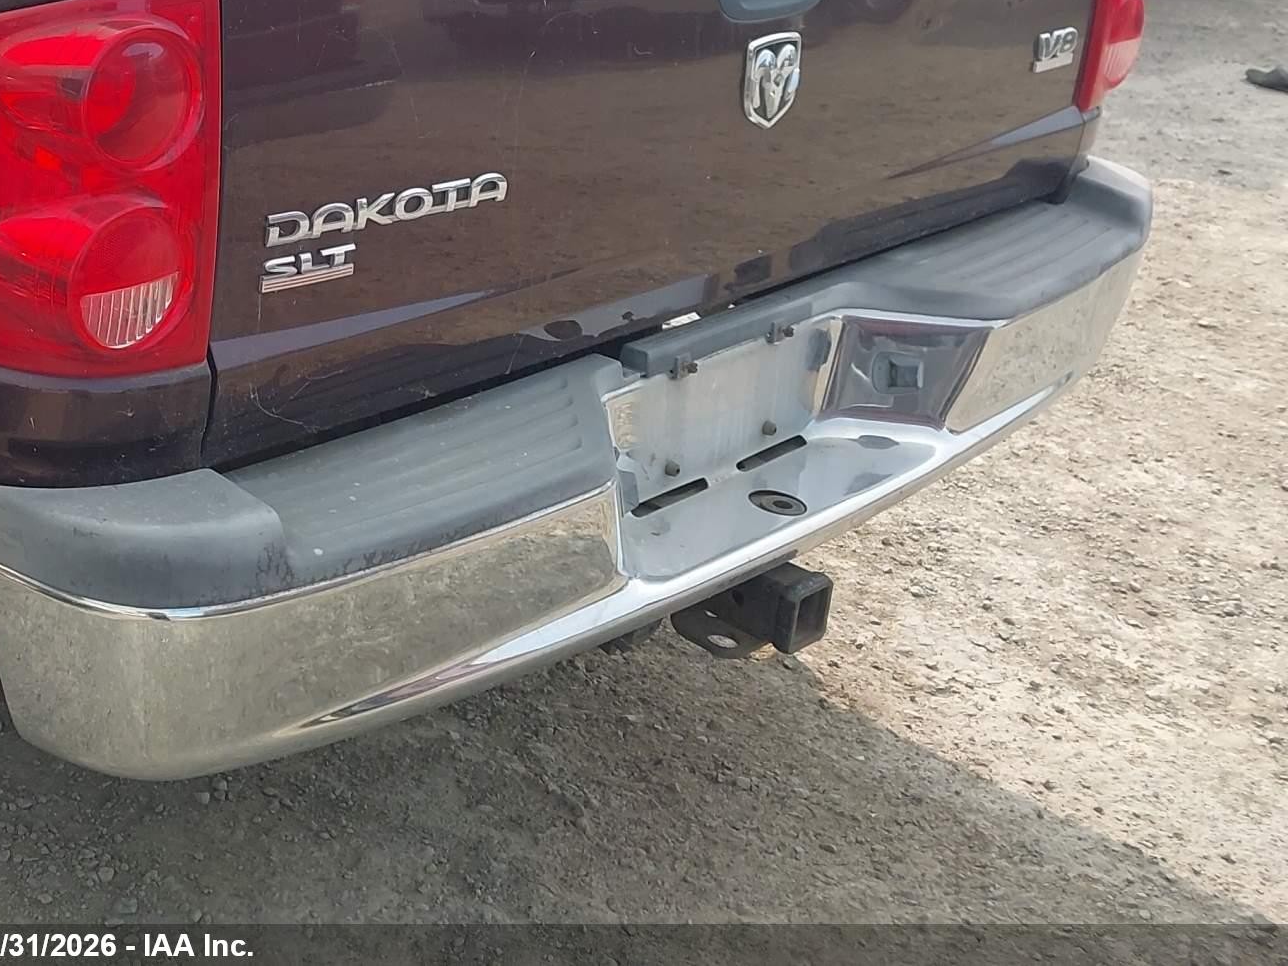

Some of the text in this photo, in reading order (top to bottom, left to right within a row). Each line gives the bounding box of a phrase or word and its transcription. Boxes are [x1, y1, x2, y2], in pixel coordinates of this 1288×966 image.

[1037, 26, 1079, 60] V8
[264, 171, 509, 248] DAKOTA
[262, 242, 357, 278] SLT
